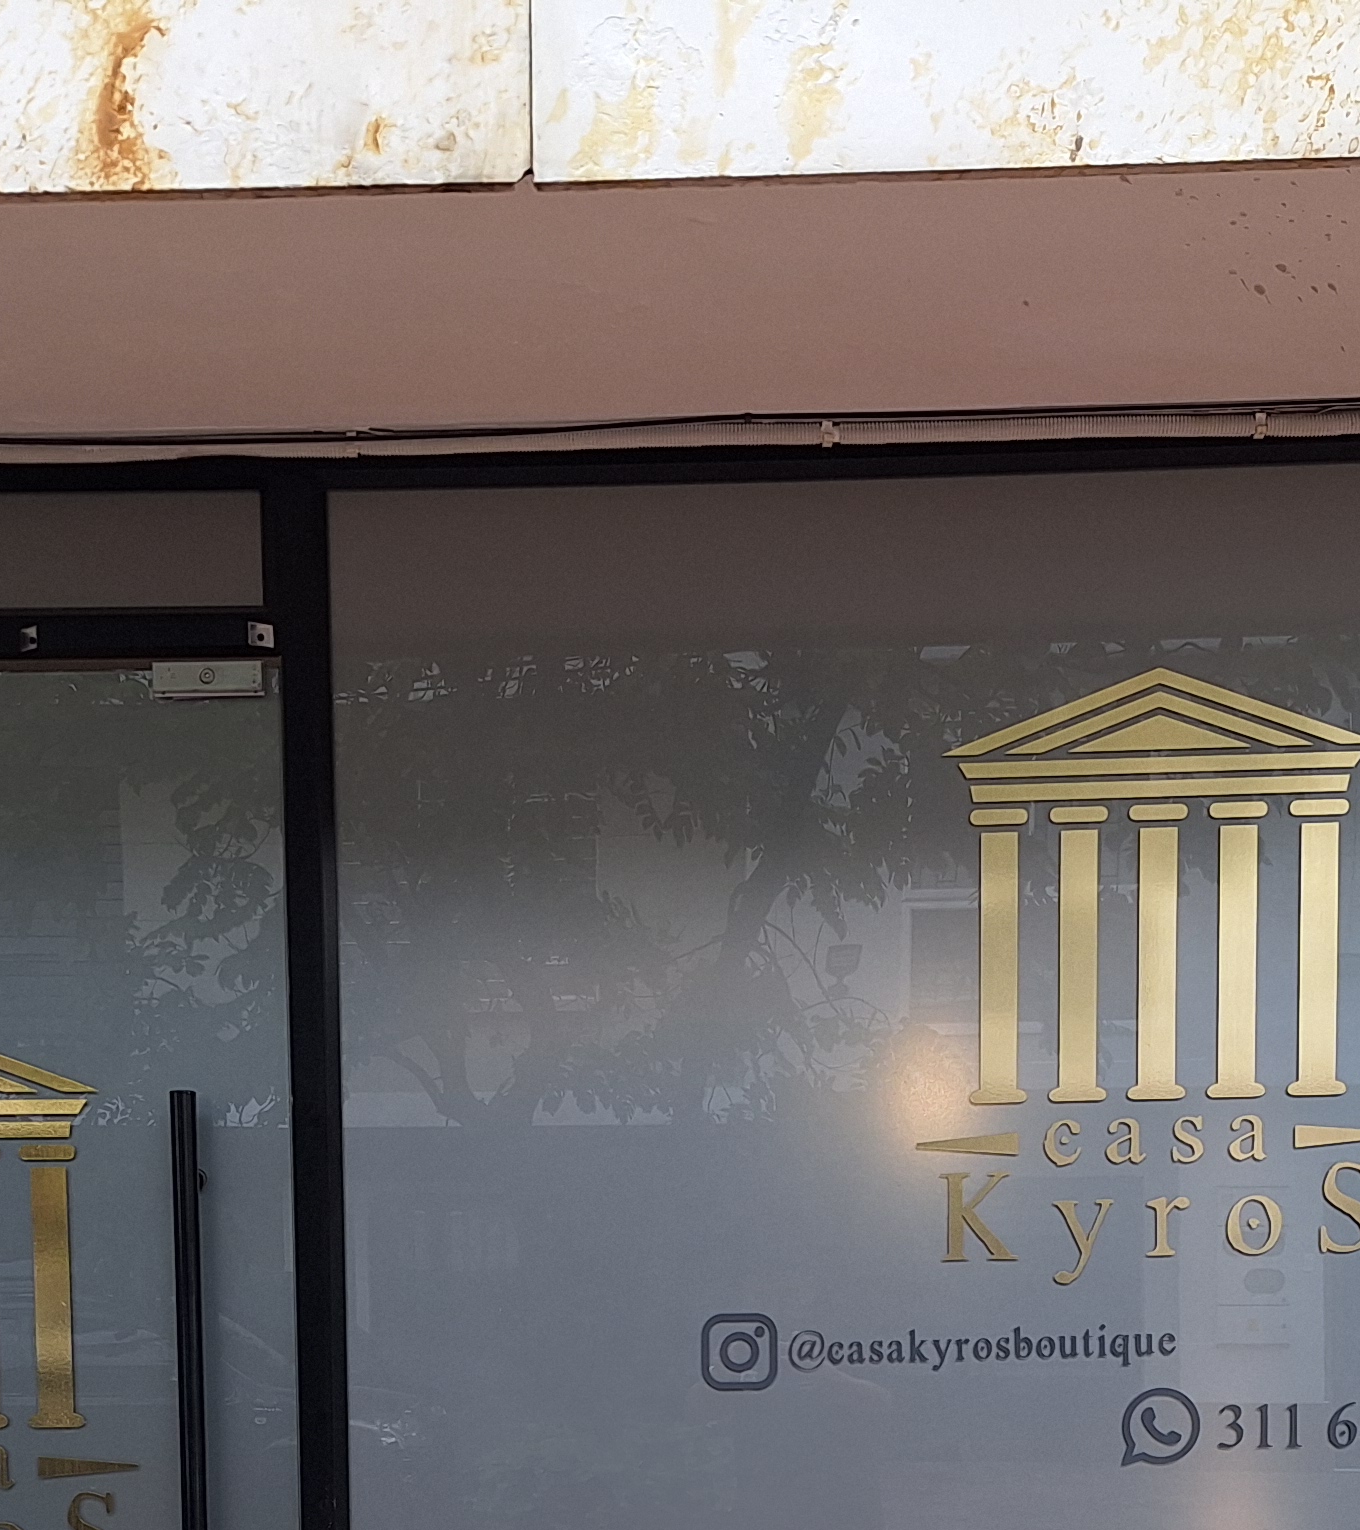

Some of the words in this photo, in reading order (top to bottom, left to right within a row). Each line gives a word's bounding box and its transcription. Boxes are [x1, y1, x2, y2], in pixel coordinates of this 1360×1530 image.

[1042, 1113, 1268, 1167] casa
[788, 1323, 1177, 1372] @casakyrosboutique
[1216, 1402, 1304, 1451] 311
